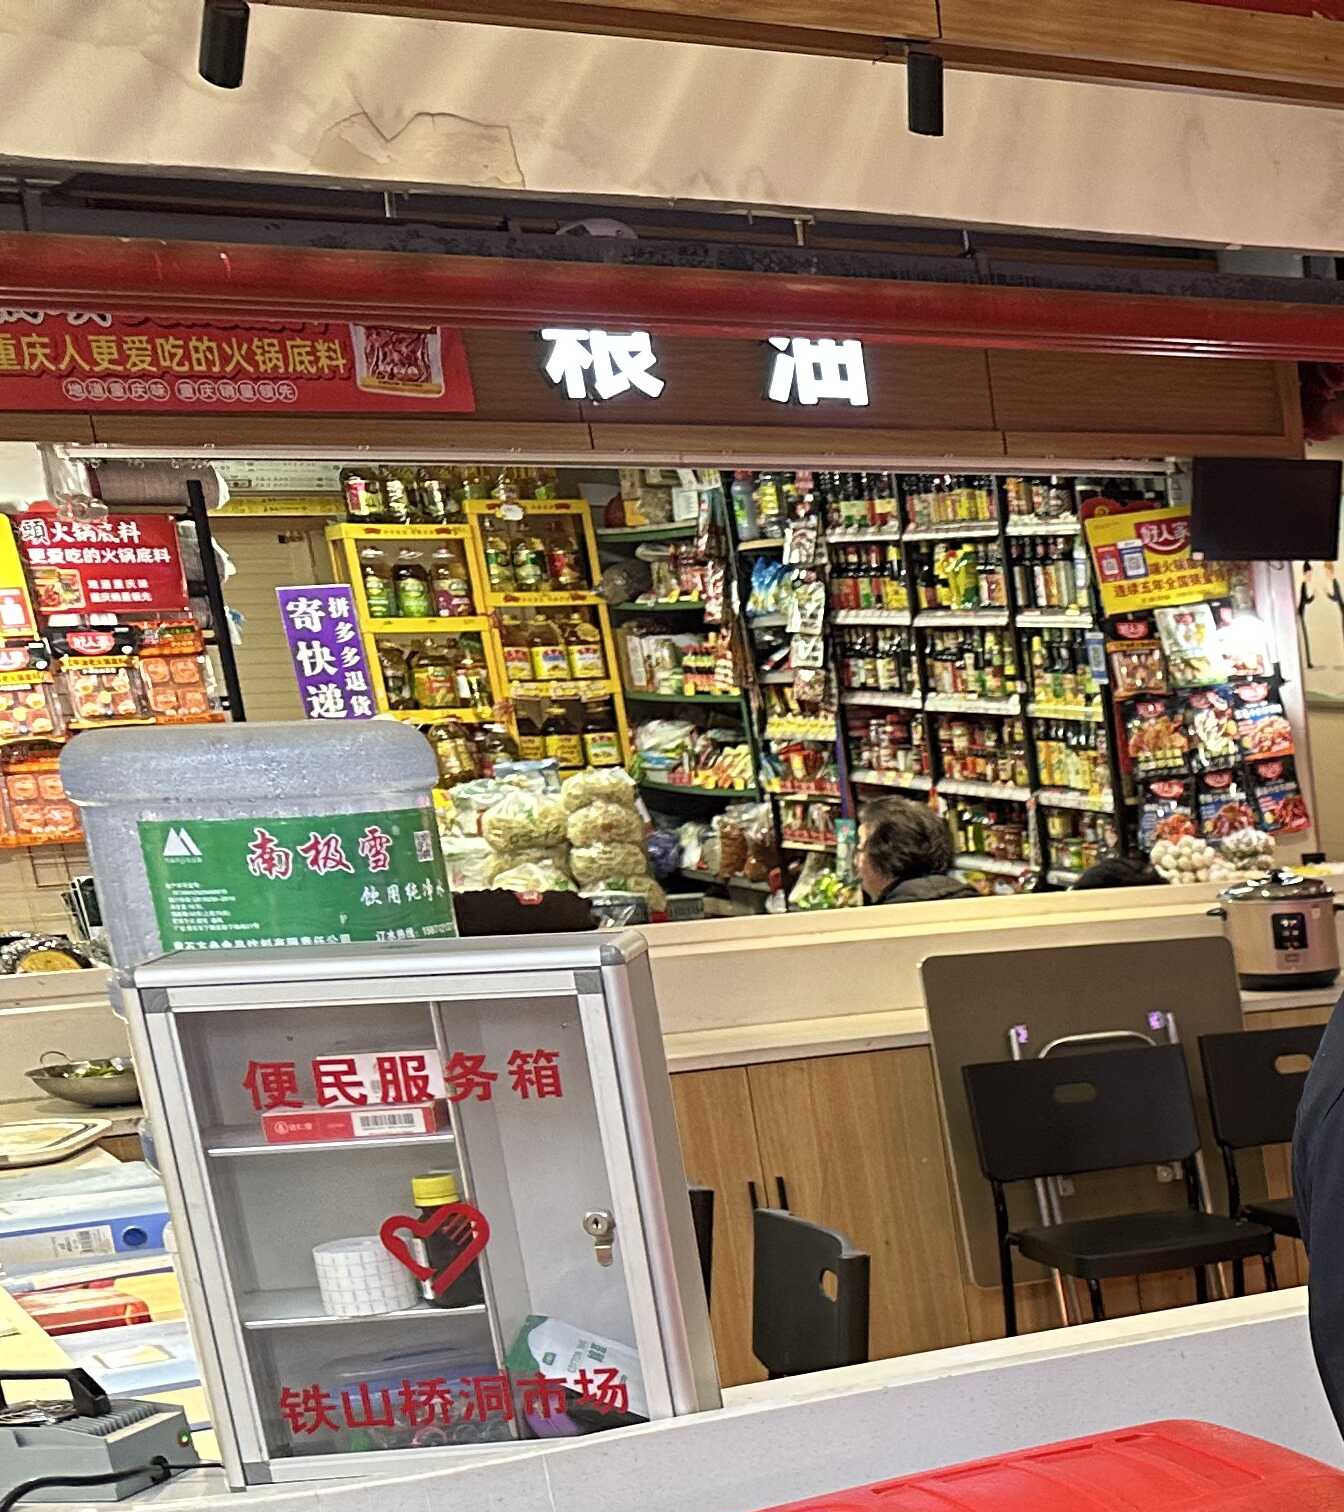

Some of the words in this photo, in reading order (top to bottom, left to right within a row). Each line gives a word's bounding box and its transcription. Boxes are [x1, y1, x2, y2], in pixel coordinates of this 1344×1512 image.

[0, 334, 346, 374] 重庆人更爱吃的火锅底料
[286, 597, 348, 719] 寄快递
[327, 597, 374, 717] 拼多多退货
[246, 825, 393, 879] 南极雪
[243, 1048, 563, 1111] 便民服务箱
[280, 1366, 629, 1435] 铁山桥洞市场
